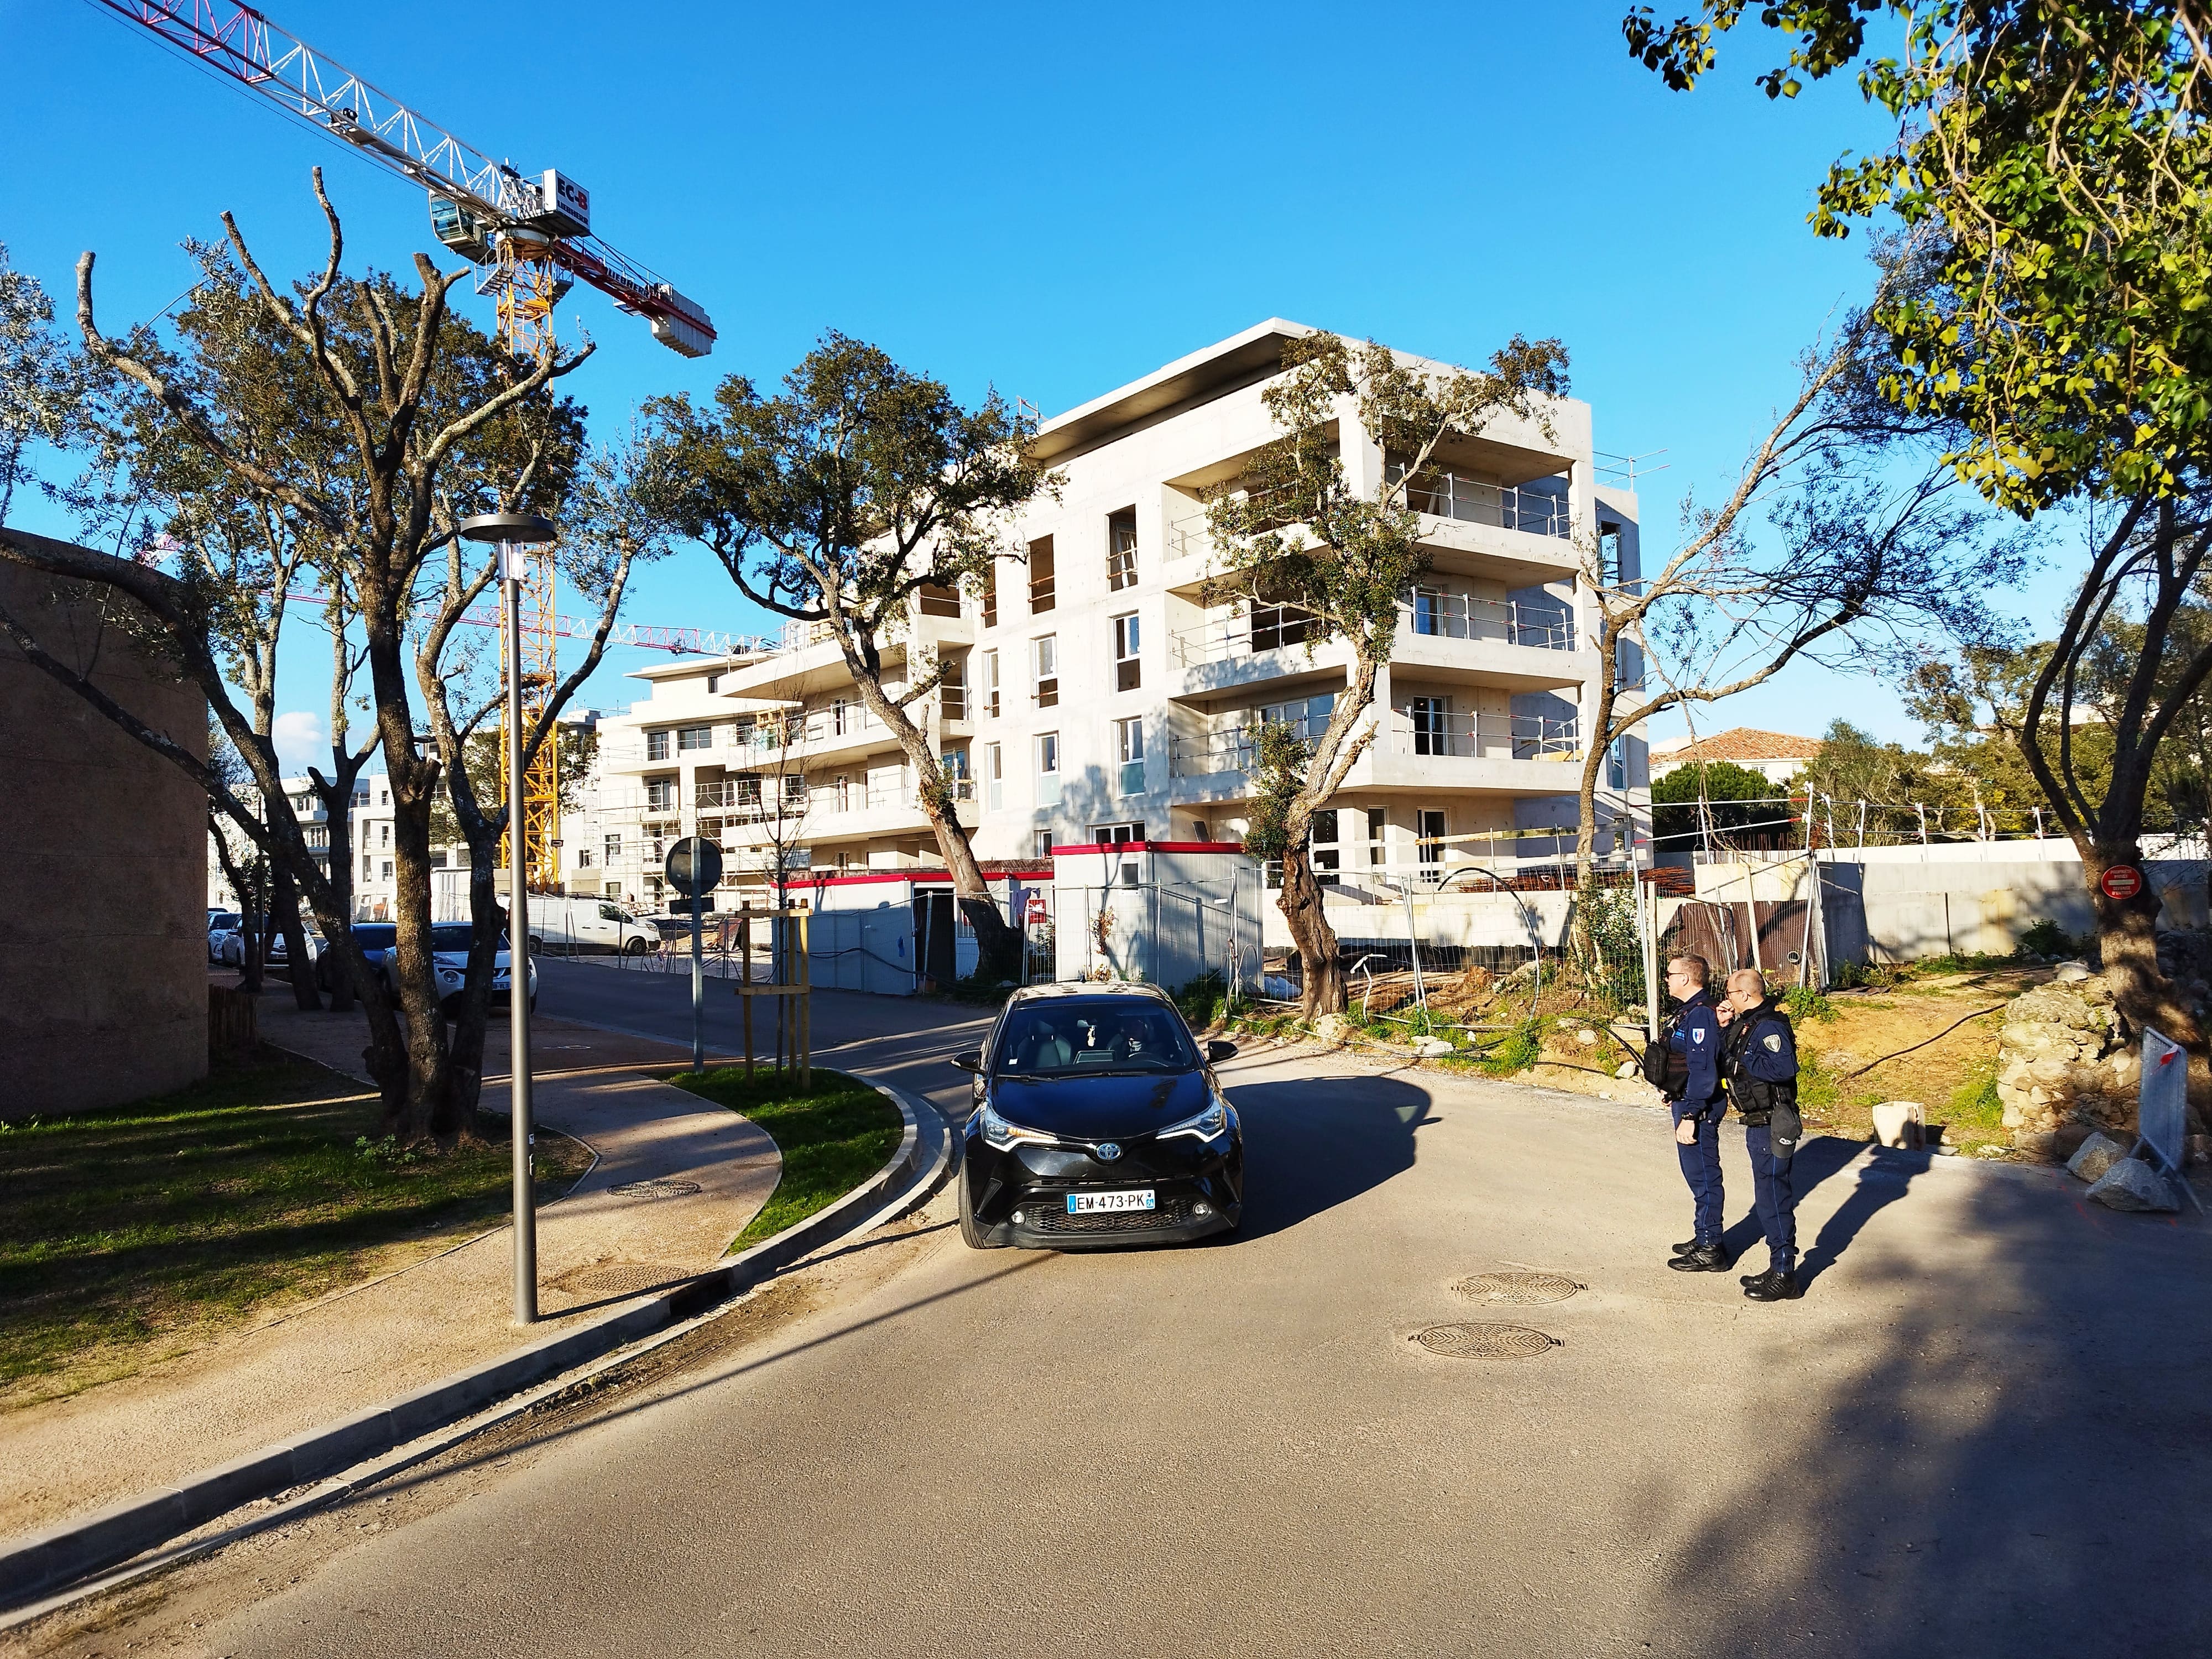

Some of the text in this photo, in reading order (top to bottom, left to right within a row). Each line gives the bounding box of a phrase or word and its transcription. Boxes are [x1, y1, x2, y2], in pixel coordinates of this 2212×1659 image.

[557, 176, 588, 211] EC-B
[557, 200, 589, 225] LIEBHERR
[608, 267, 649, 299] LIEBHERR
[1077, 1193, 1145, 1210] EM-473-PK
